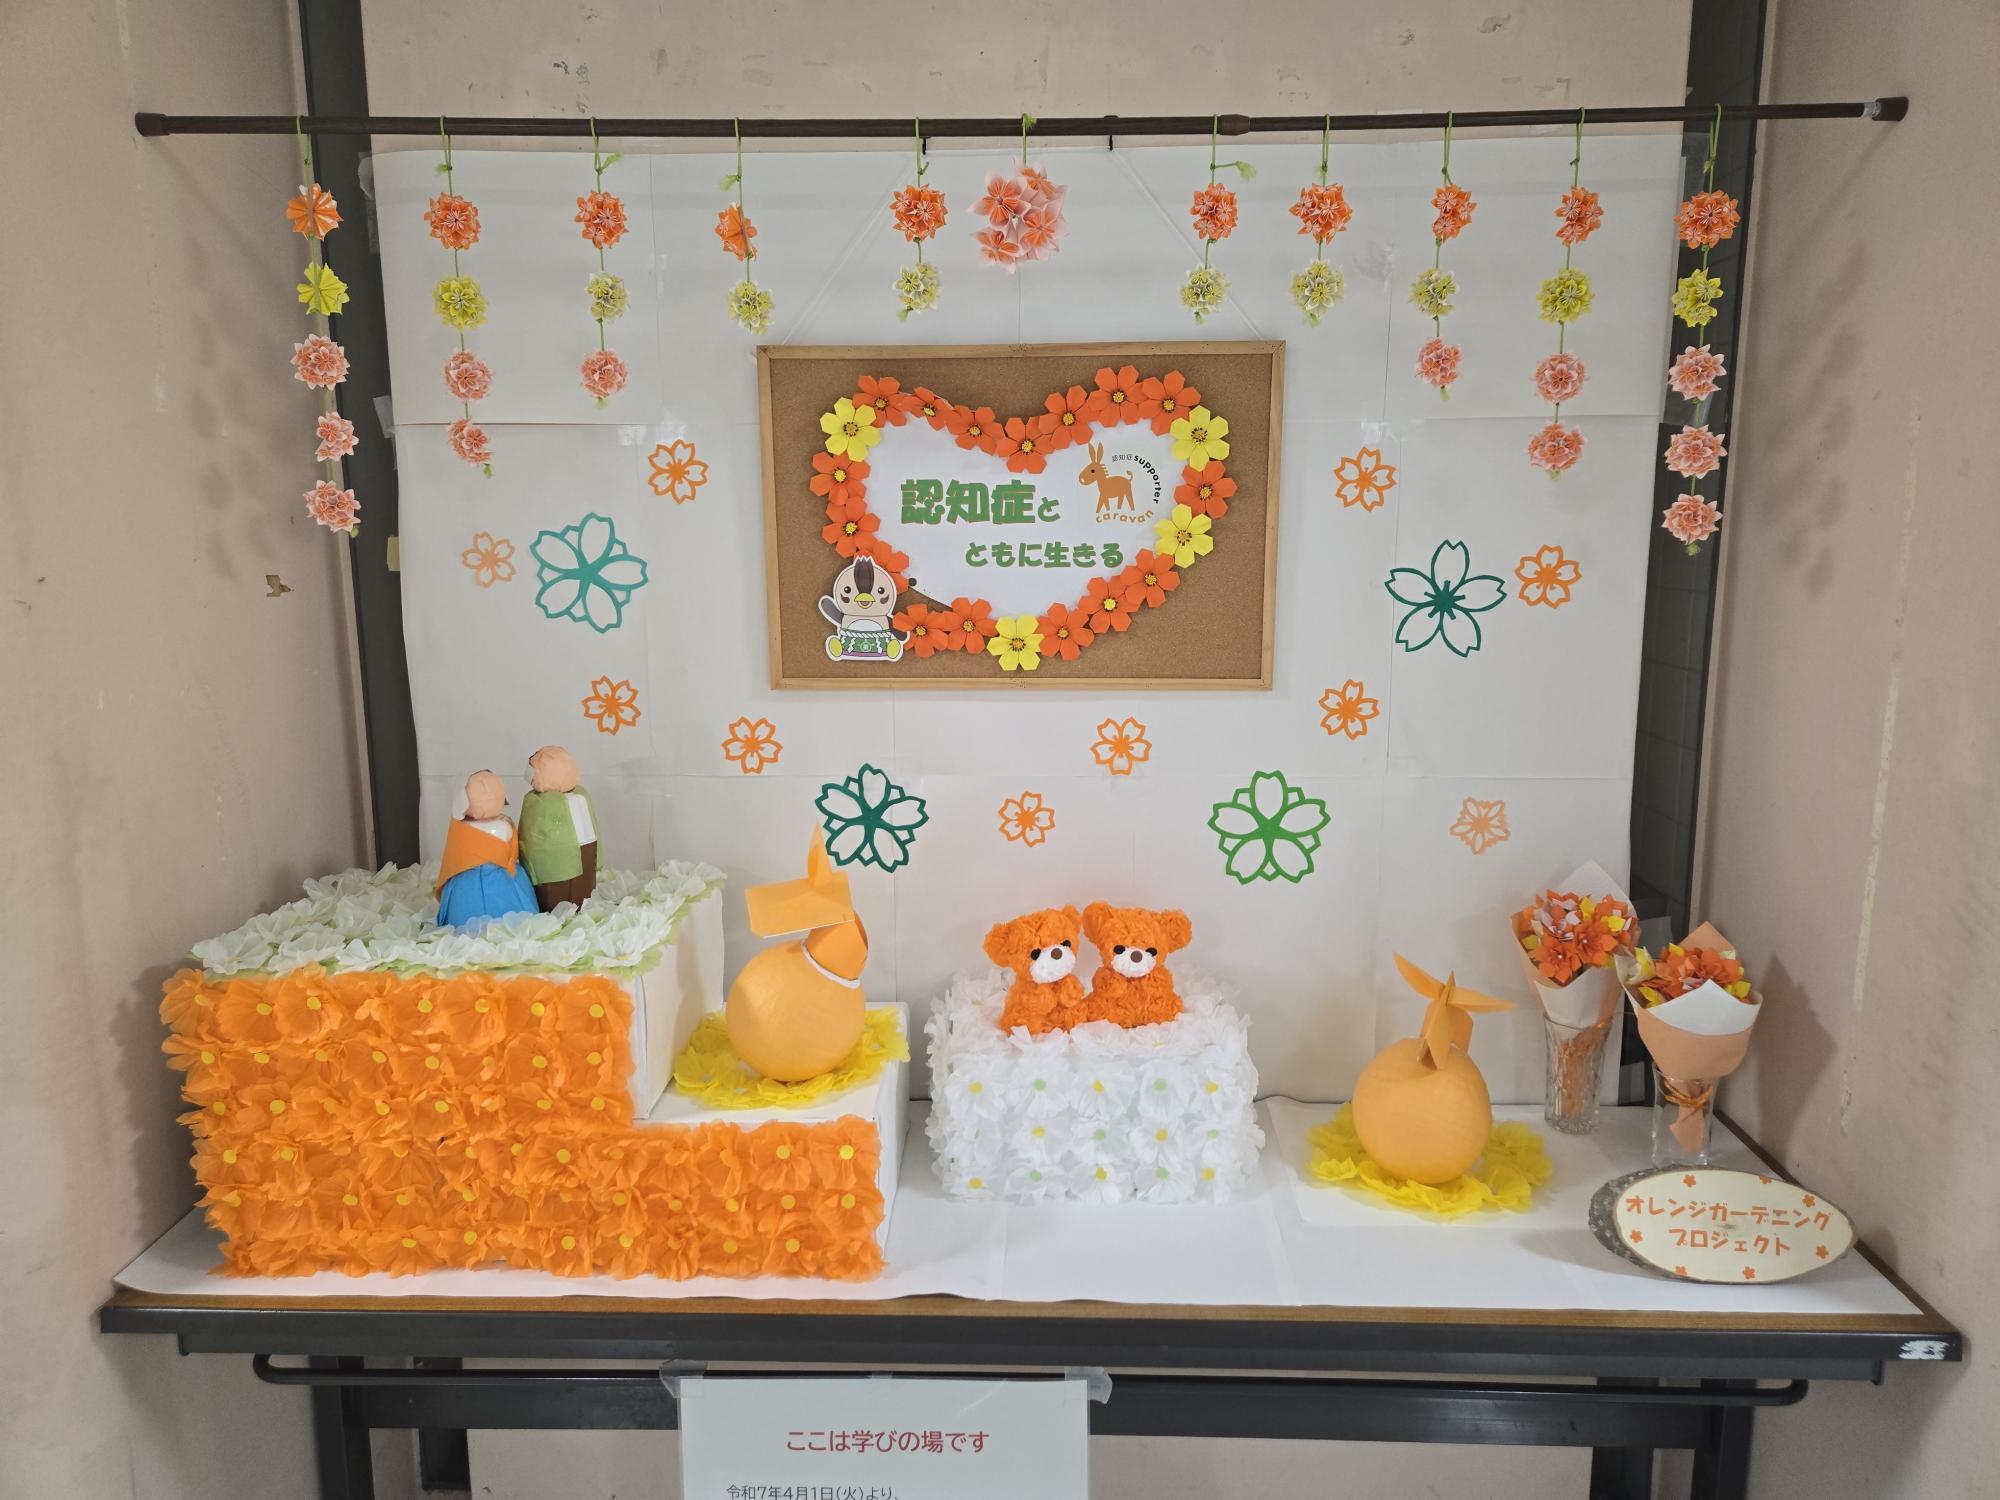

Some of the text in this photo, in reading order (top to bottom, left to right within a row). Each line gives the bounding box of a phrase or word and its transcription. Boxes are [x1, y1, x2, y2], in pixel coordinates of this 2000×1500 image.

[1133, 455, 1161, 504] supporter
[900, 479, 1061, 525] 認知症と
[1095, 509, 1154, 524] caravan
[965, 541, 1124, 568] ともに生きる
[1626, 1195, 1834, 1231] オレンジガーデニング
[1668, 1228, 1791, 1256] プロジェクト
[786, 1429, 990, 1453] ここは学びの場です
